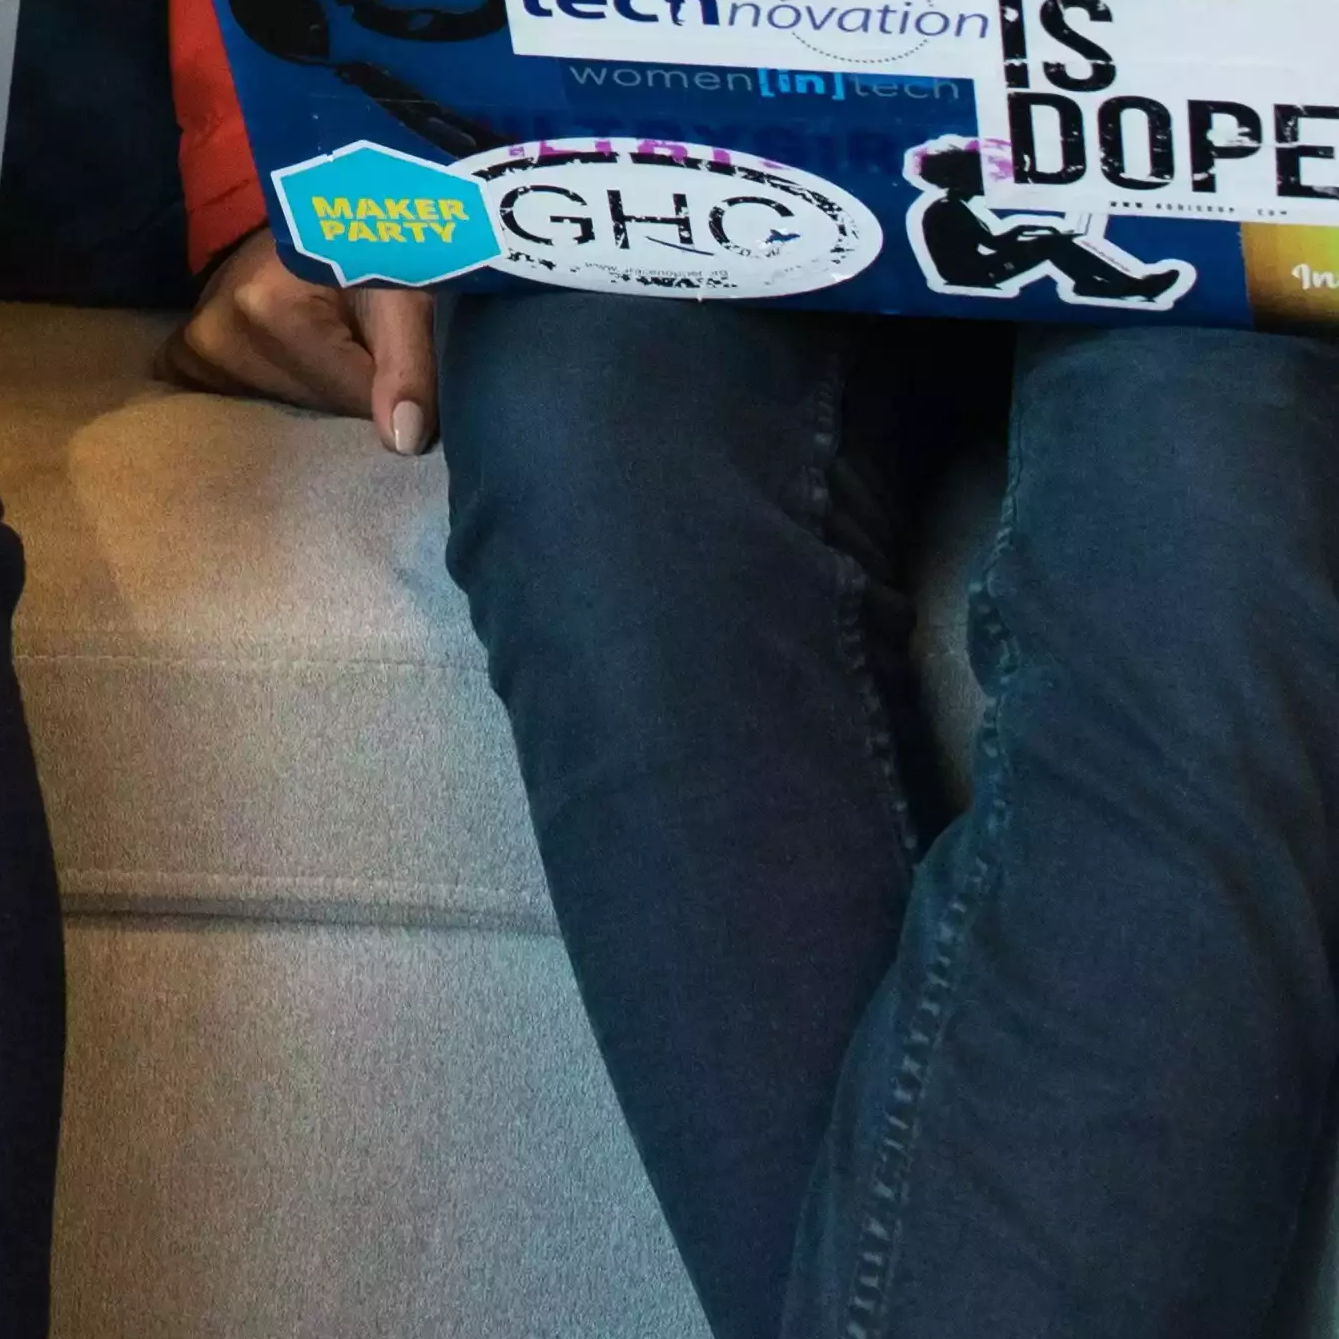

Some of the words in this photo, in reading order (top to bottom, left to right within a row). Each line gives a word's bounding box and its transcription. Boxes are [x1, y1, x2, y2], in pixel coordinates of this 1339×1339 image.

[1007, 92, 1339, 200] DOPE
[311, 196, 470, 221] MAKER
[319, 219, 457, 243] PARTY
[499, 184, 798, 258] GHC
